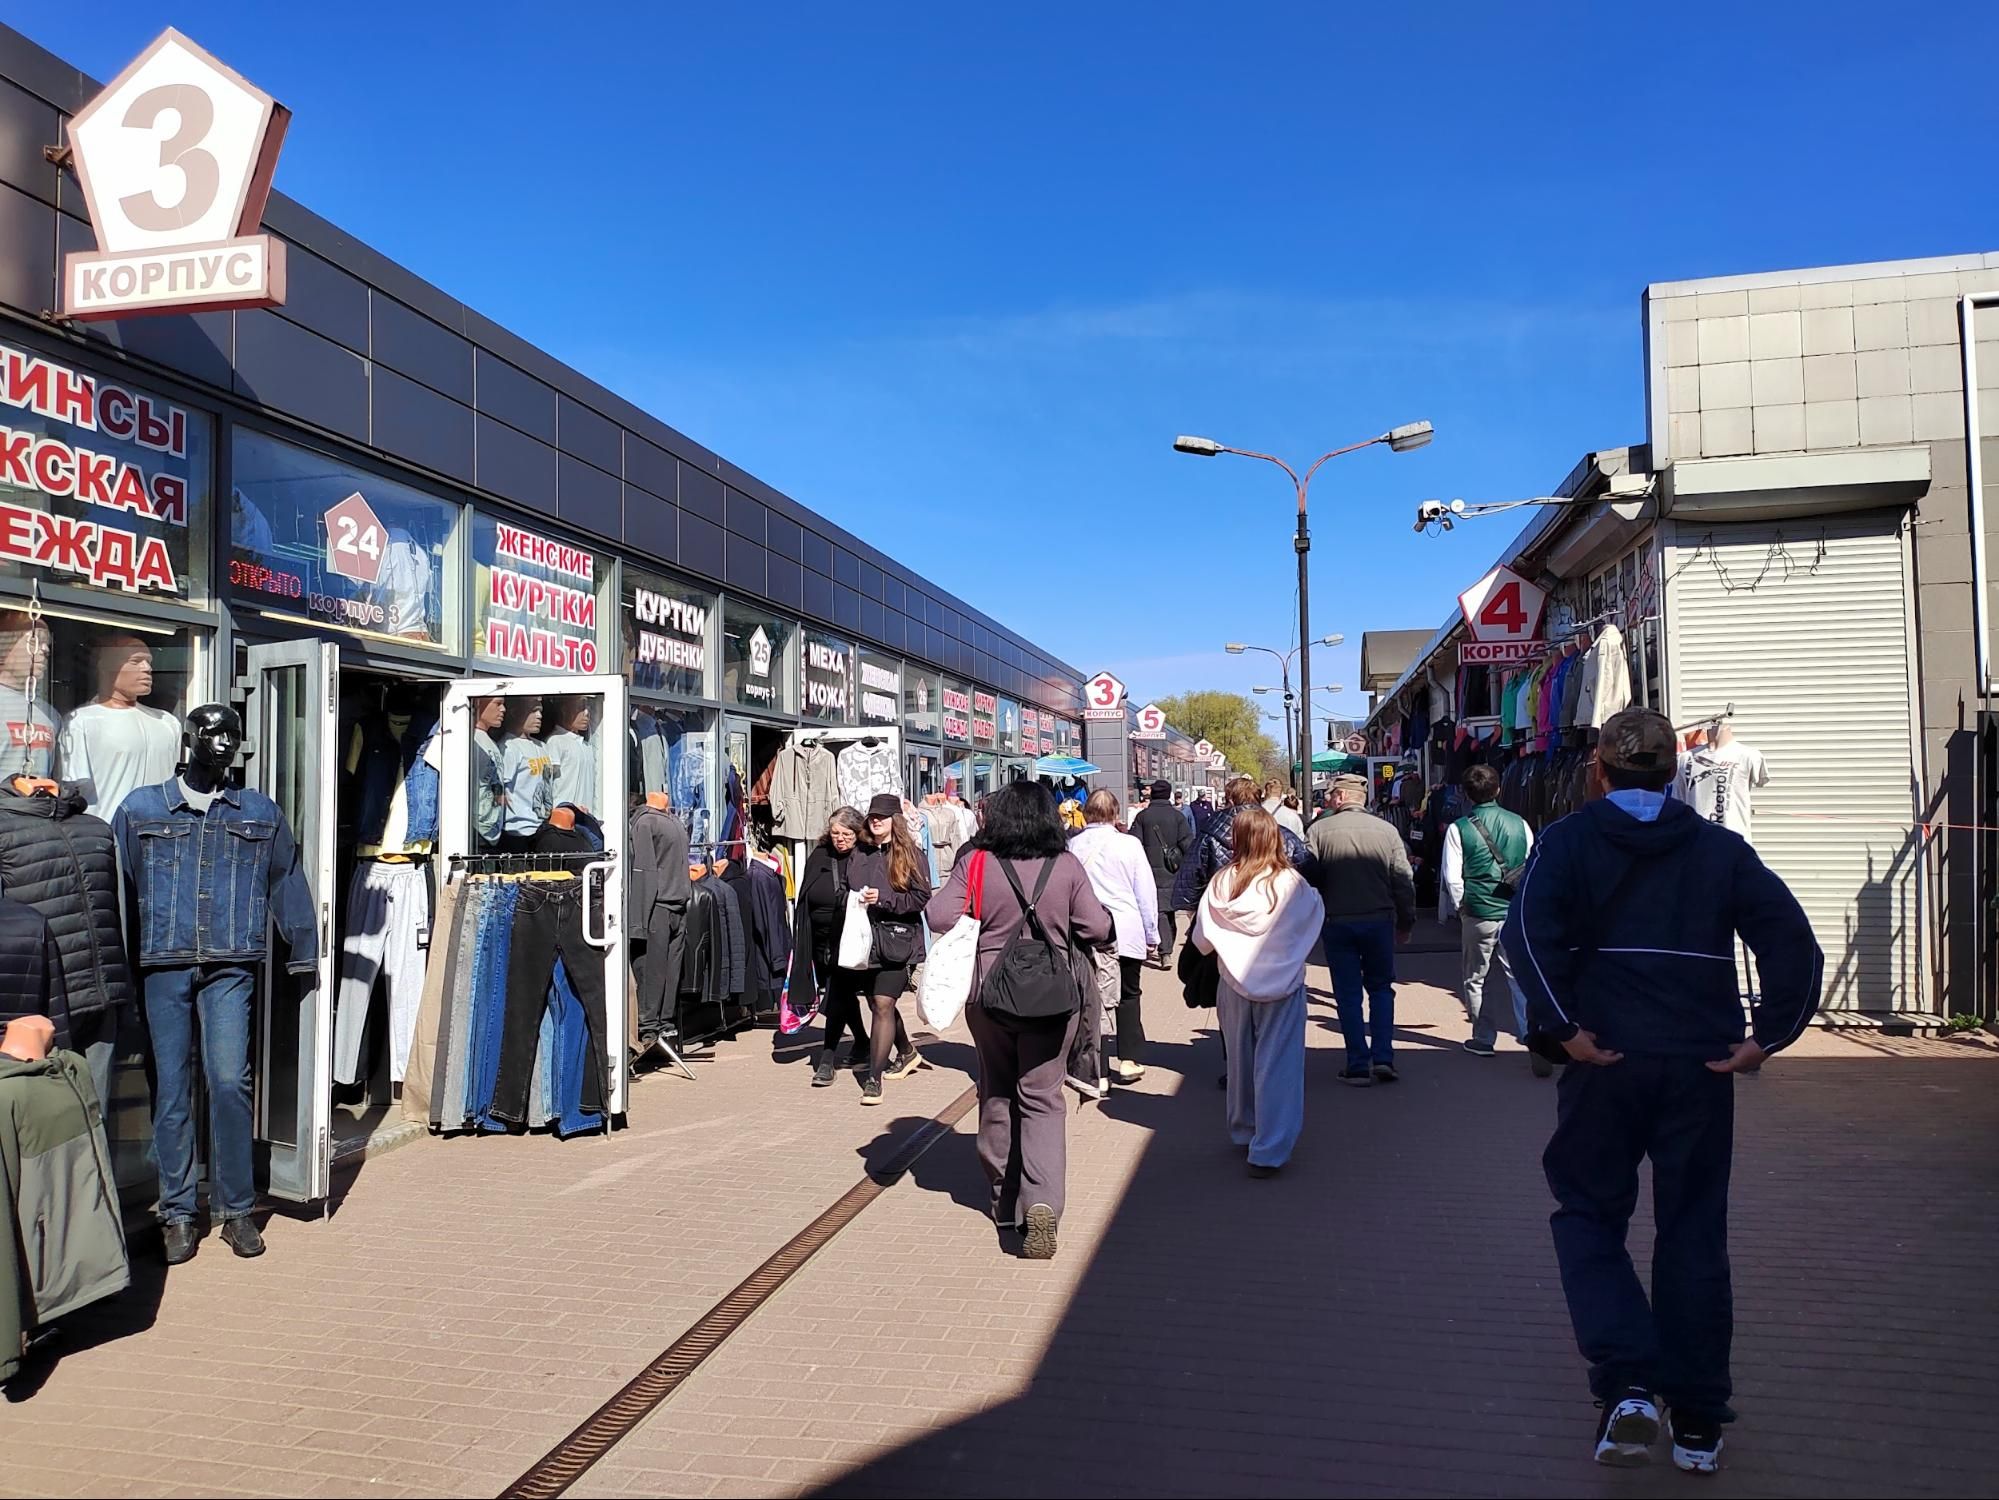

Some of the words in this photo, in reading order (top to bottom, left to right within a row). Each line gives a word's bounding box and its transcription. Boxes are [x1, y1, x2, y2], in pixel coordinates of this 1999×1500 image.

[118, 83, 220, 232] 3
[81, 252, 253, 299] КОРПУС
[0, 344, 187, 460] ИНСЫ
[0, 503, 178, 593] ЕЖДА
[337, 515, 380, 560] 24
[496, 522, 593, 581] ЖЕНСКИЕ
[229, 560, 302, 598] ОТКРЫТО
[490, 565, 596, 630] КУРТКИ
[309, 591, 384, 624] корпус
[389, 604, 400, 624] 3
[635, 587, 705, 636] КУРТКИ
[1481, 582, 1528, 633] 4
[487, 617, 598, 675] ПАЛЬТО
[638, 630, 705, 671] ДУБЛЕНКИ
[754, 641, 769, 664] 25
[809, 641, 845, 675] МЕХА
[1464, 645, 1549, 660] КОРПУС
[745, 683, 770, 701] корпус
[809, 681, 847, 709] КОЖА
[1094, 679, 1115, 705] 3
[1143, 710, 1159, 730] 5
[1199, 743, 1209, 756] 5
[1213, 754, 1221, 765] 7
[1710, 767, 1728, 824] Reebok
